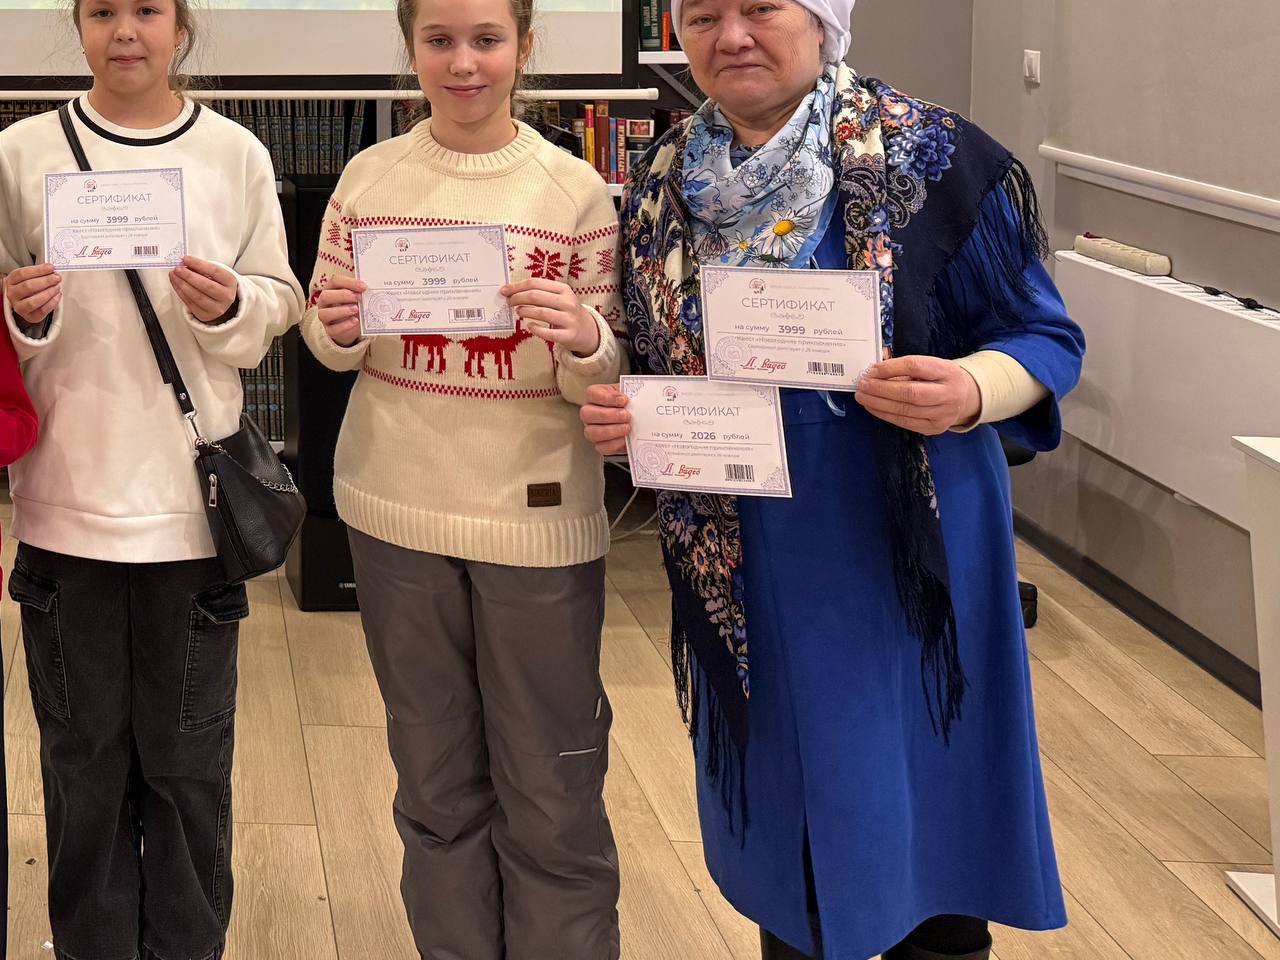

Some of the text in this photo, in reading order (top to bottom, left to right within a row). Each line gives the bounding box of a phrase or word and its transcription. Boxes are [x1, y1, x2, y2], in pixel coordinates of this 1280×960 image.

[76, 193, 153, 205] СЕРТИФИКАТ
[106, 216, 129, 224] 3999
[388, 252, 471, 266] СЕРТИФИКАТ
[422, 277, 447, 286] 3999
[741, 297, 837, 312] СЕРТИФИКАТ
[778, 324, 806, 335] 3999
[655, 405, 742, 417] СЕРТИФИКАТ
[690, 431, 717, 440] 2026
